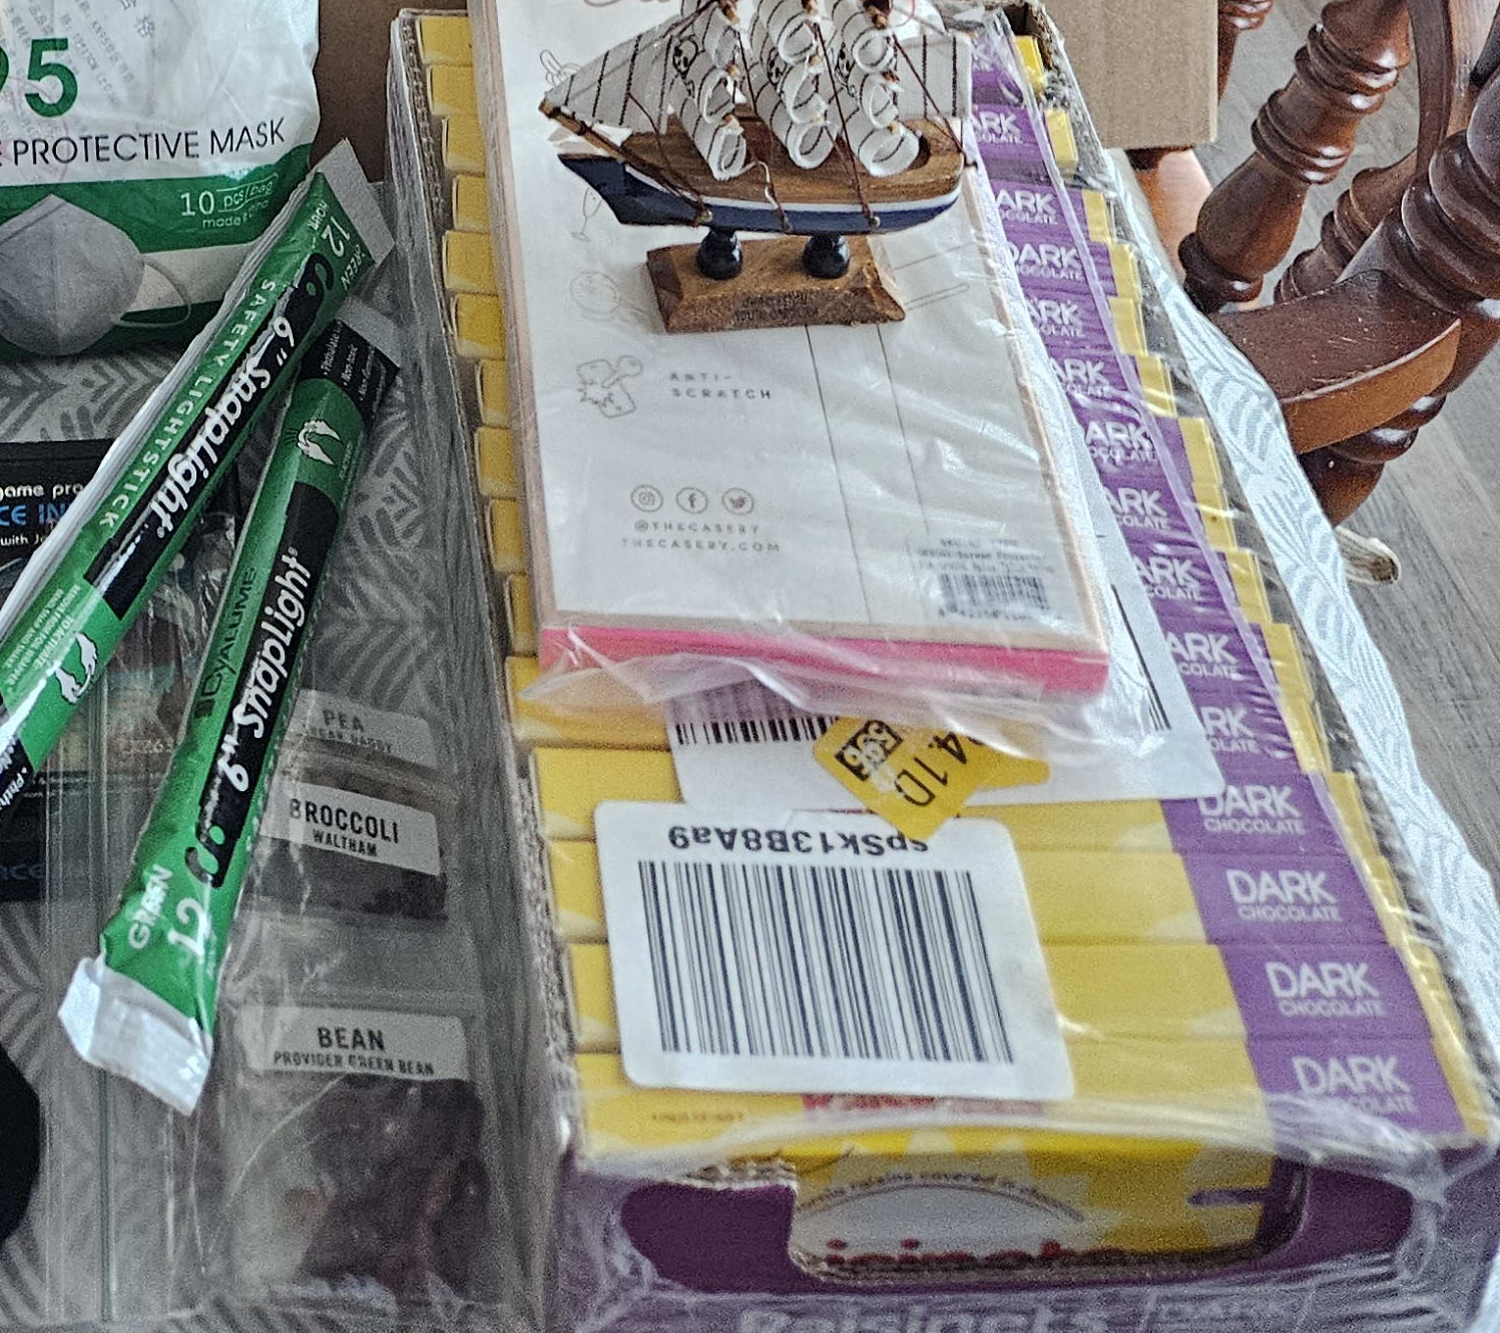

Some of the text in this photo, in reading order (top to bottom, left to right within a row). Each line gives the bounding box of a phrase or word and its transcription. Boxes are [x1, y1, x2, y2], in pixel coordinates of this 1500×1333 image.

[971, 110, 1021, 134] ARK
[13, 131, 200, 166] PROTECTIVE
[210, 116, 286, 158] MASK
[181, 190, 215, 216] 10
[995, 188, 1056, 213] ARK
[322, 218, 351, 257] 12
[212, 279, 276, 367] SAFETY
[1024, 298, 1086, 325] ARK
[1050, 357, 1110, 385] ARK
[1084, 420, 1152, 449] ARK
[1104, 487, 1168, 518] ARK
[0, 533, 29, 549] with
[1133, 555, 1198, 589] ARK
[1166, 633, 1237, 665] ARK
[1178, 661, 1239, 680] COLATE
[322, 708, 365, 733] PEA
[1200, 706, 1253, 738] RK
[289, 799, 399, 845] BROCCOLI
[312, 828, 379, 858] WALTHAM
[1226, 868, 1339, 905] DARK
[1238, 904, 1343, 923] CHOCOLATE
[1265, 960, 1381, 998] DARK
[1278, 998, 1388, 1018] CHOCOLATE
[316, 1026, 385, 1051] BEAN
[273, 1051, 434, 1075] PROVIDER GREEN BEAN
[1292, 1055, 1411, 1094] DARK
